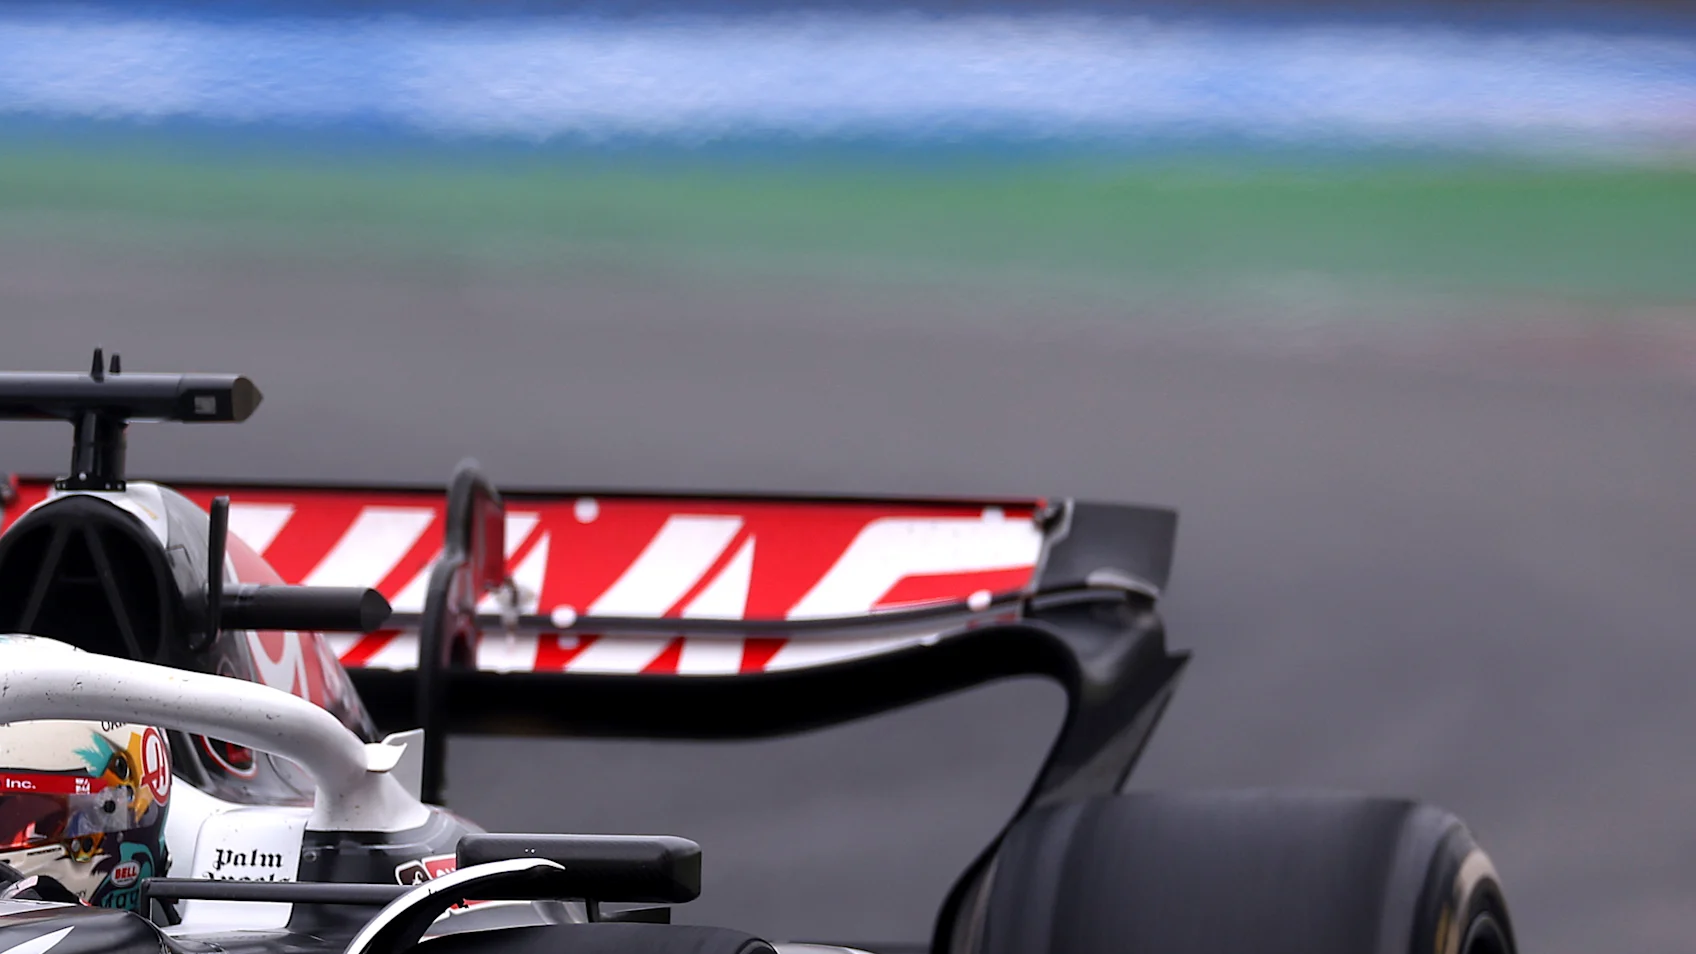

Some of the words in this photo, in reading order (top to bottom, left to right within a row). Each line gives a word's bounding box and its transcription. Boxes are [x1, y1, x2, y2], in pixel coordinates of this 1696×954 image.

[5, 777, 37, 790] Inc.
[212, 848, 284, 871] Palm
[114, 865, 137, 880] BELL
